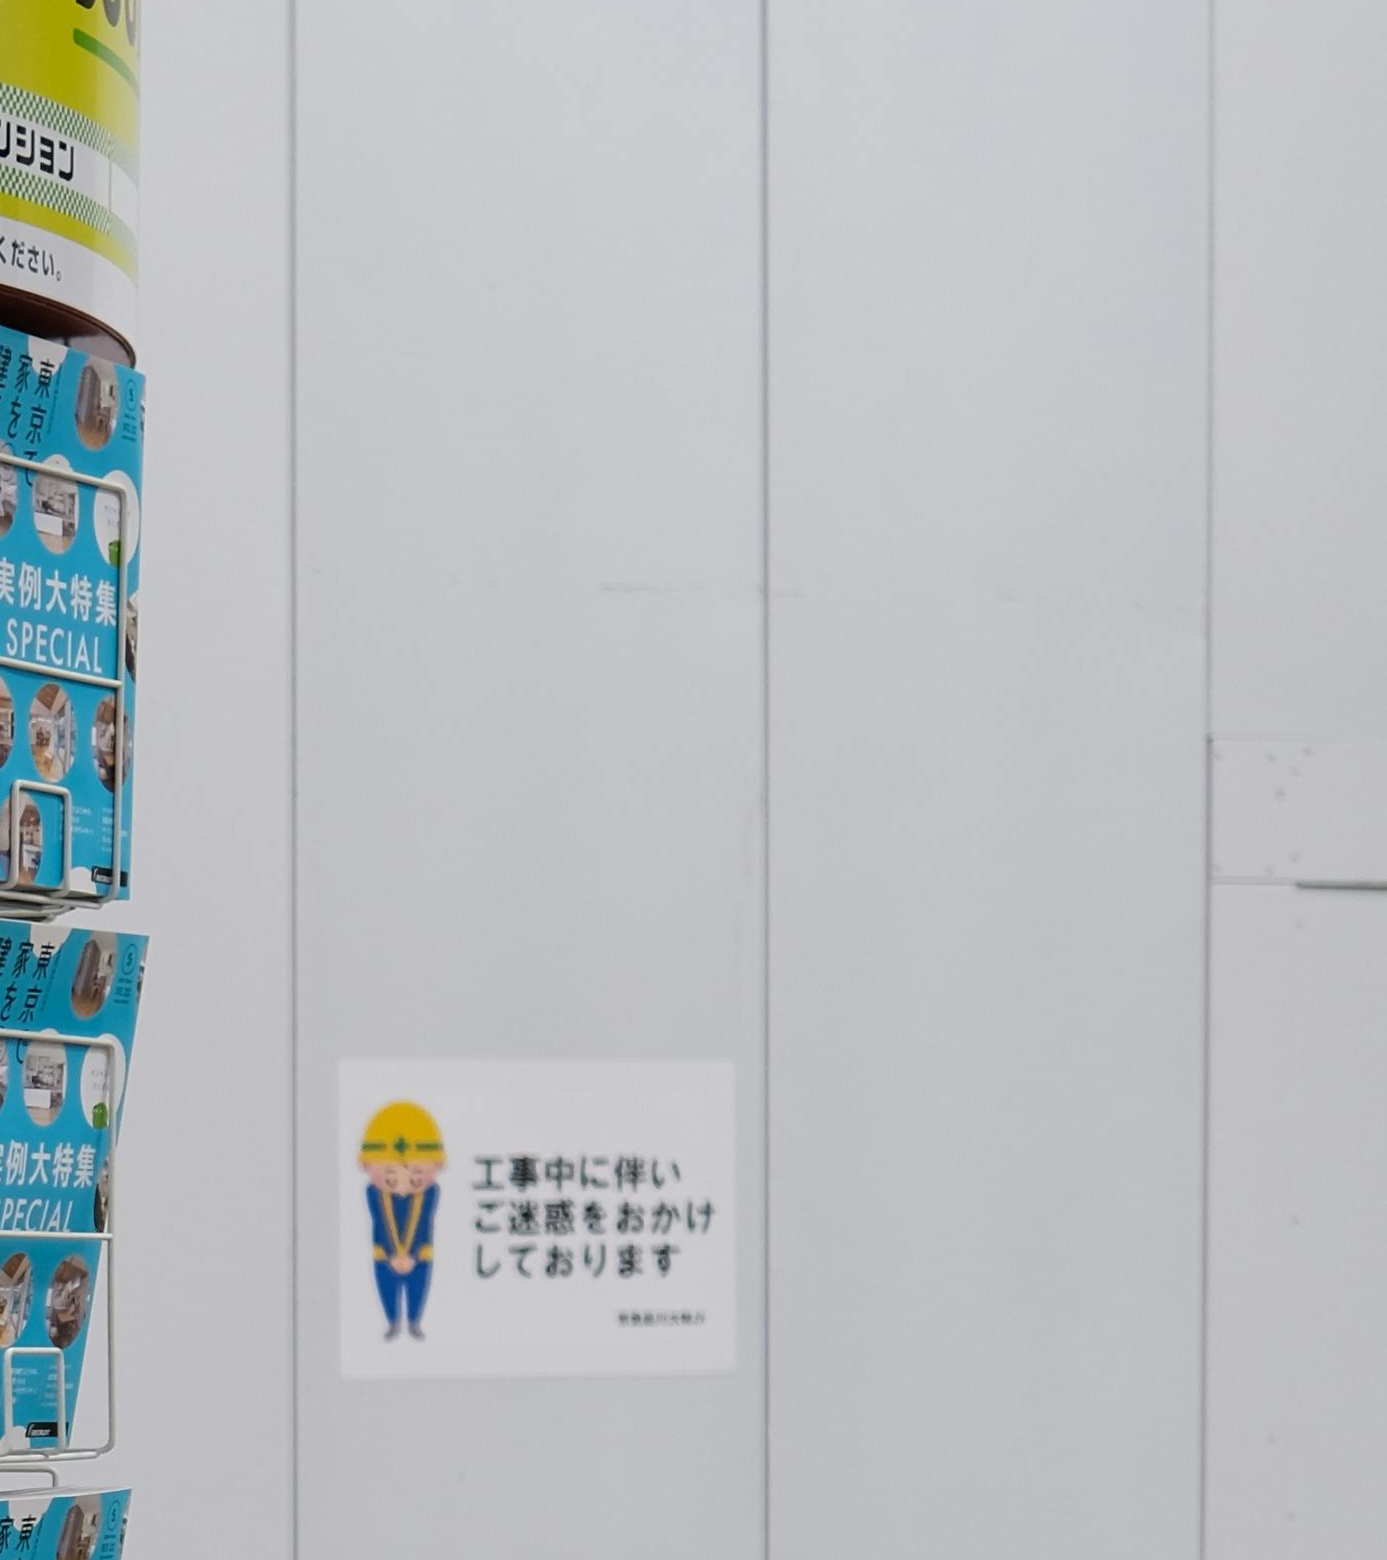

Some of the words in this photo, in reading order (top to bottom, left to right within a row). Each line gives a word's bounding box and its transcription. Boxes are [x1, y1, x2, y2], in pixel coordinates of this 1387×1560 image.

[6, 616, 104, 674] SPECIAL
[472, 1156, 681, 1190] 工事中に伴い
[474, 1200, 716, 1236] ご迷惑をおかけ
[474, 1244, 681, 1278] しております
